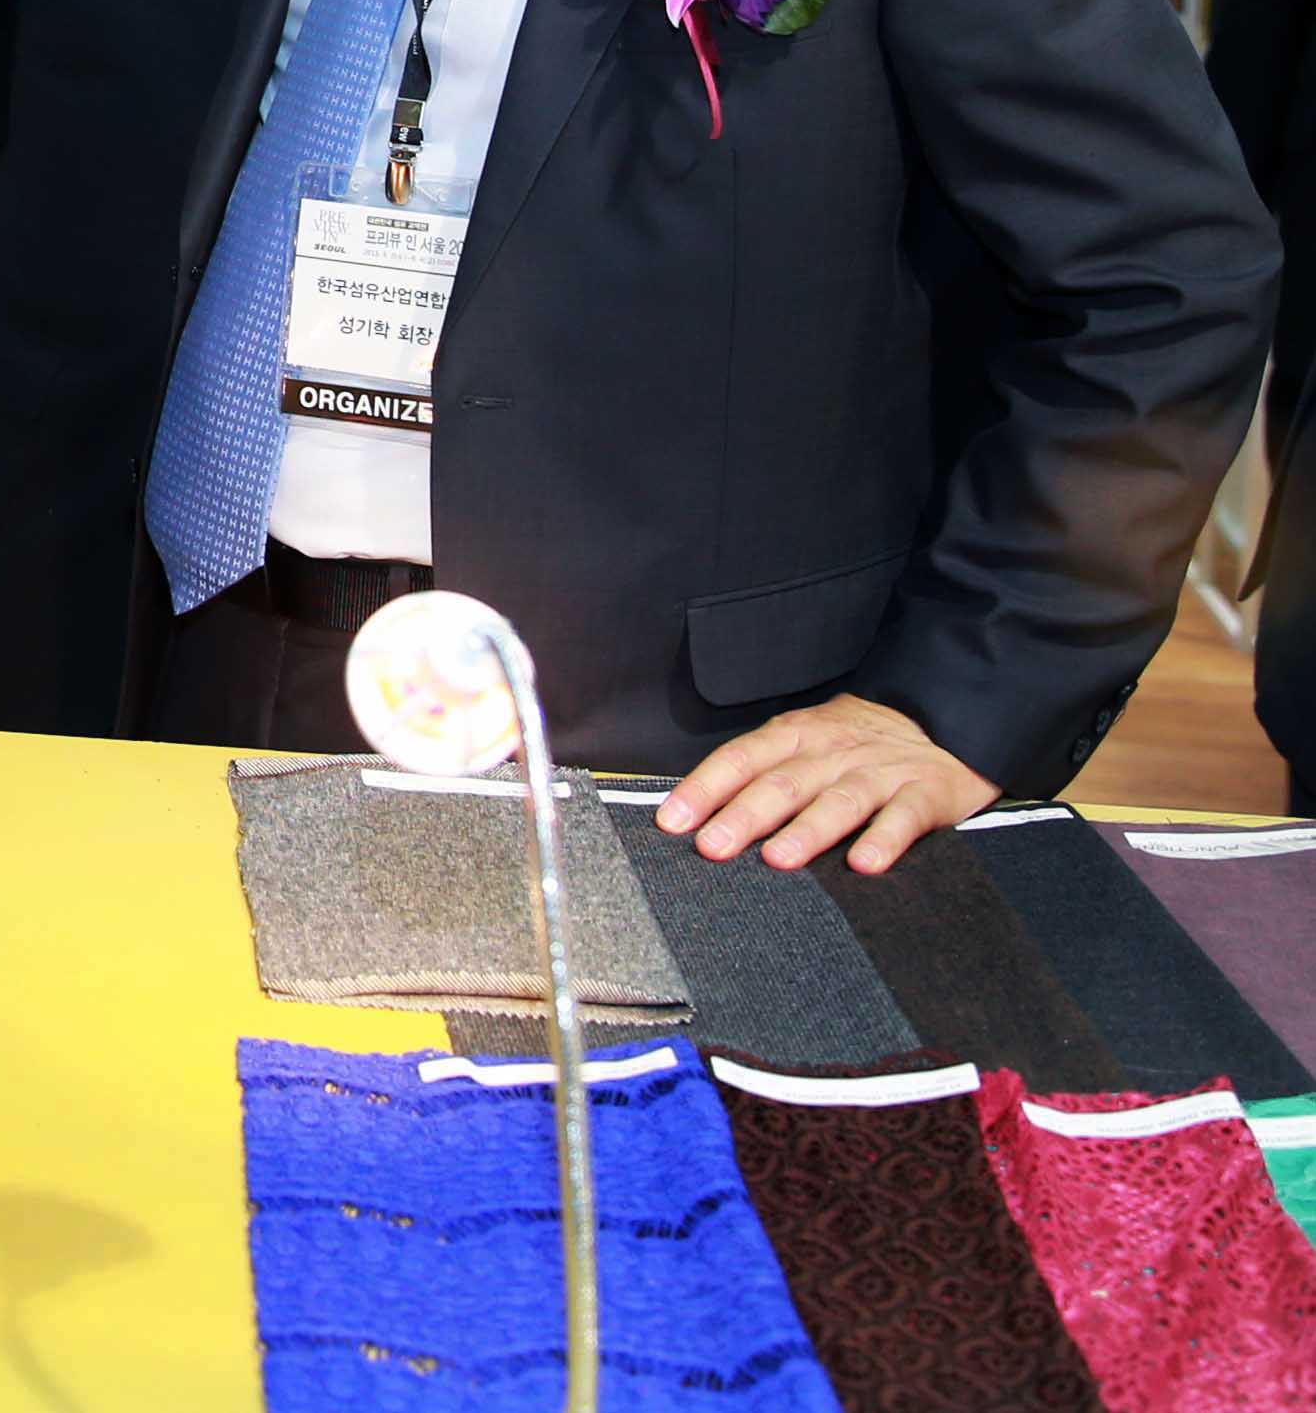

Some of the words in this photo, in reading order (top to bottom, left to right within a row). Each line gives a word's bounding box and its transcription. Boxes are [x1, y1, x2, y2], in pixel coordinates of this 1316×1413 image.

[365, 229, 402, 250] 프리뷰
[405, 234, 418, 252] 인
[420, 236, 446, 256] 서울
[318, 276, 450, 310] 한국섬유산업연합
[339, 315, 390, 339] 성기학
[398, 324, 434, 346] 회장
[299, 386, 434, 425] ORGANIZE
